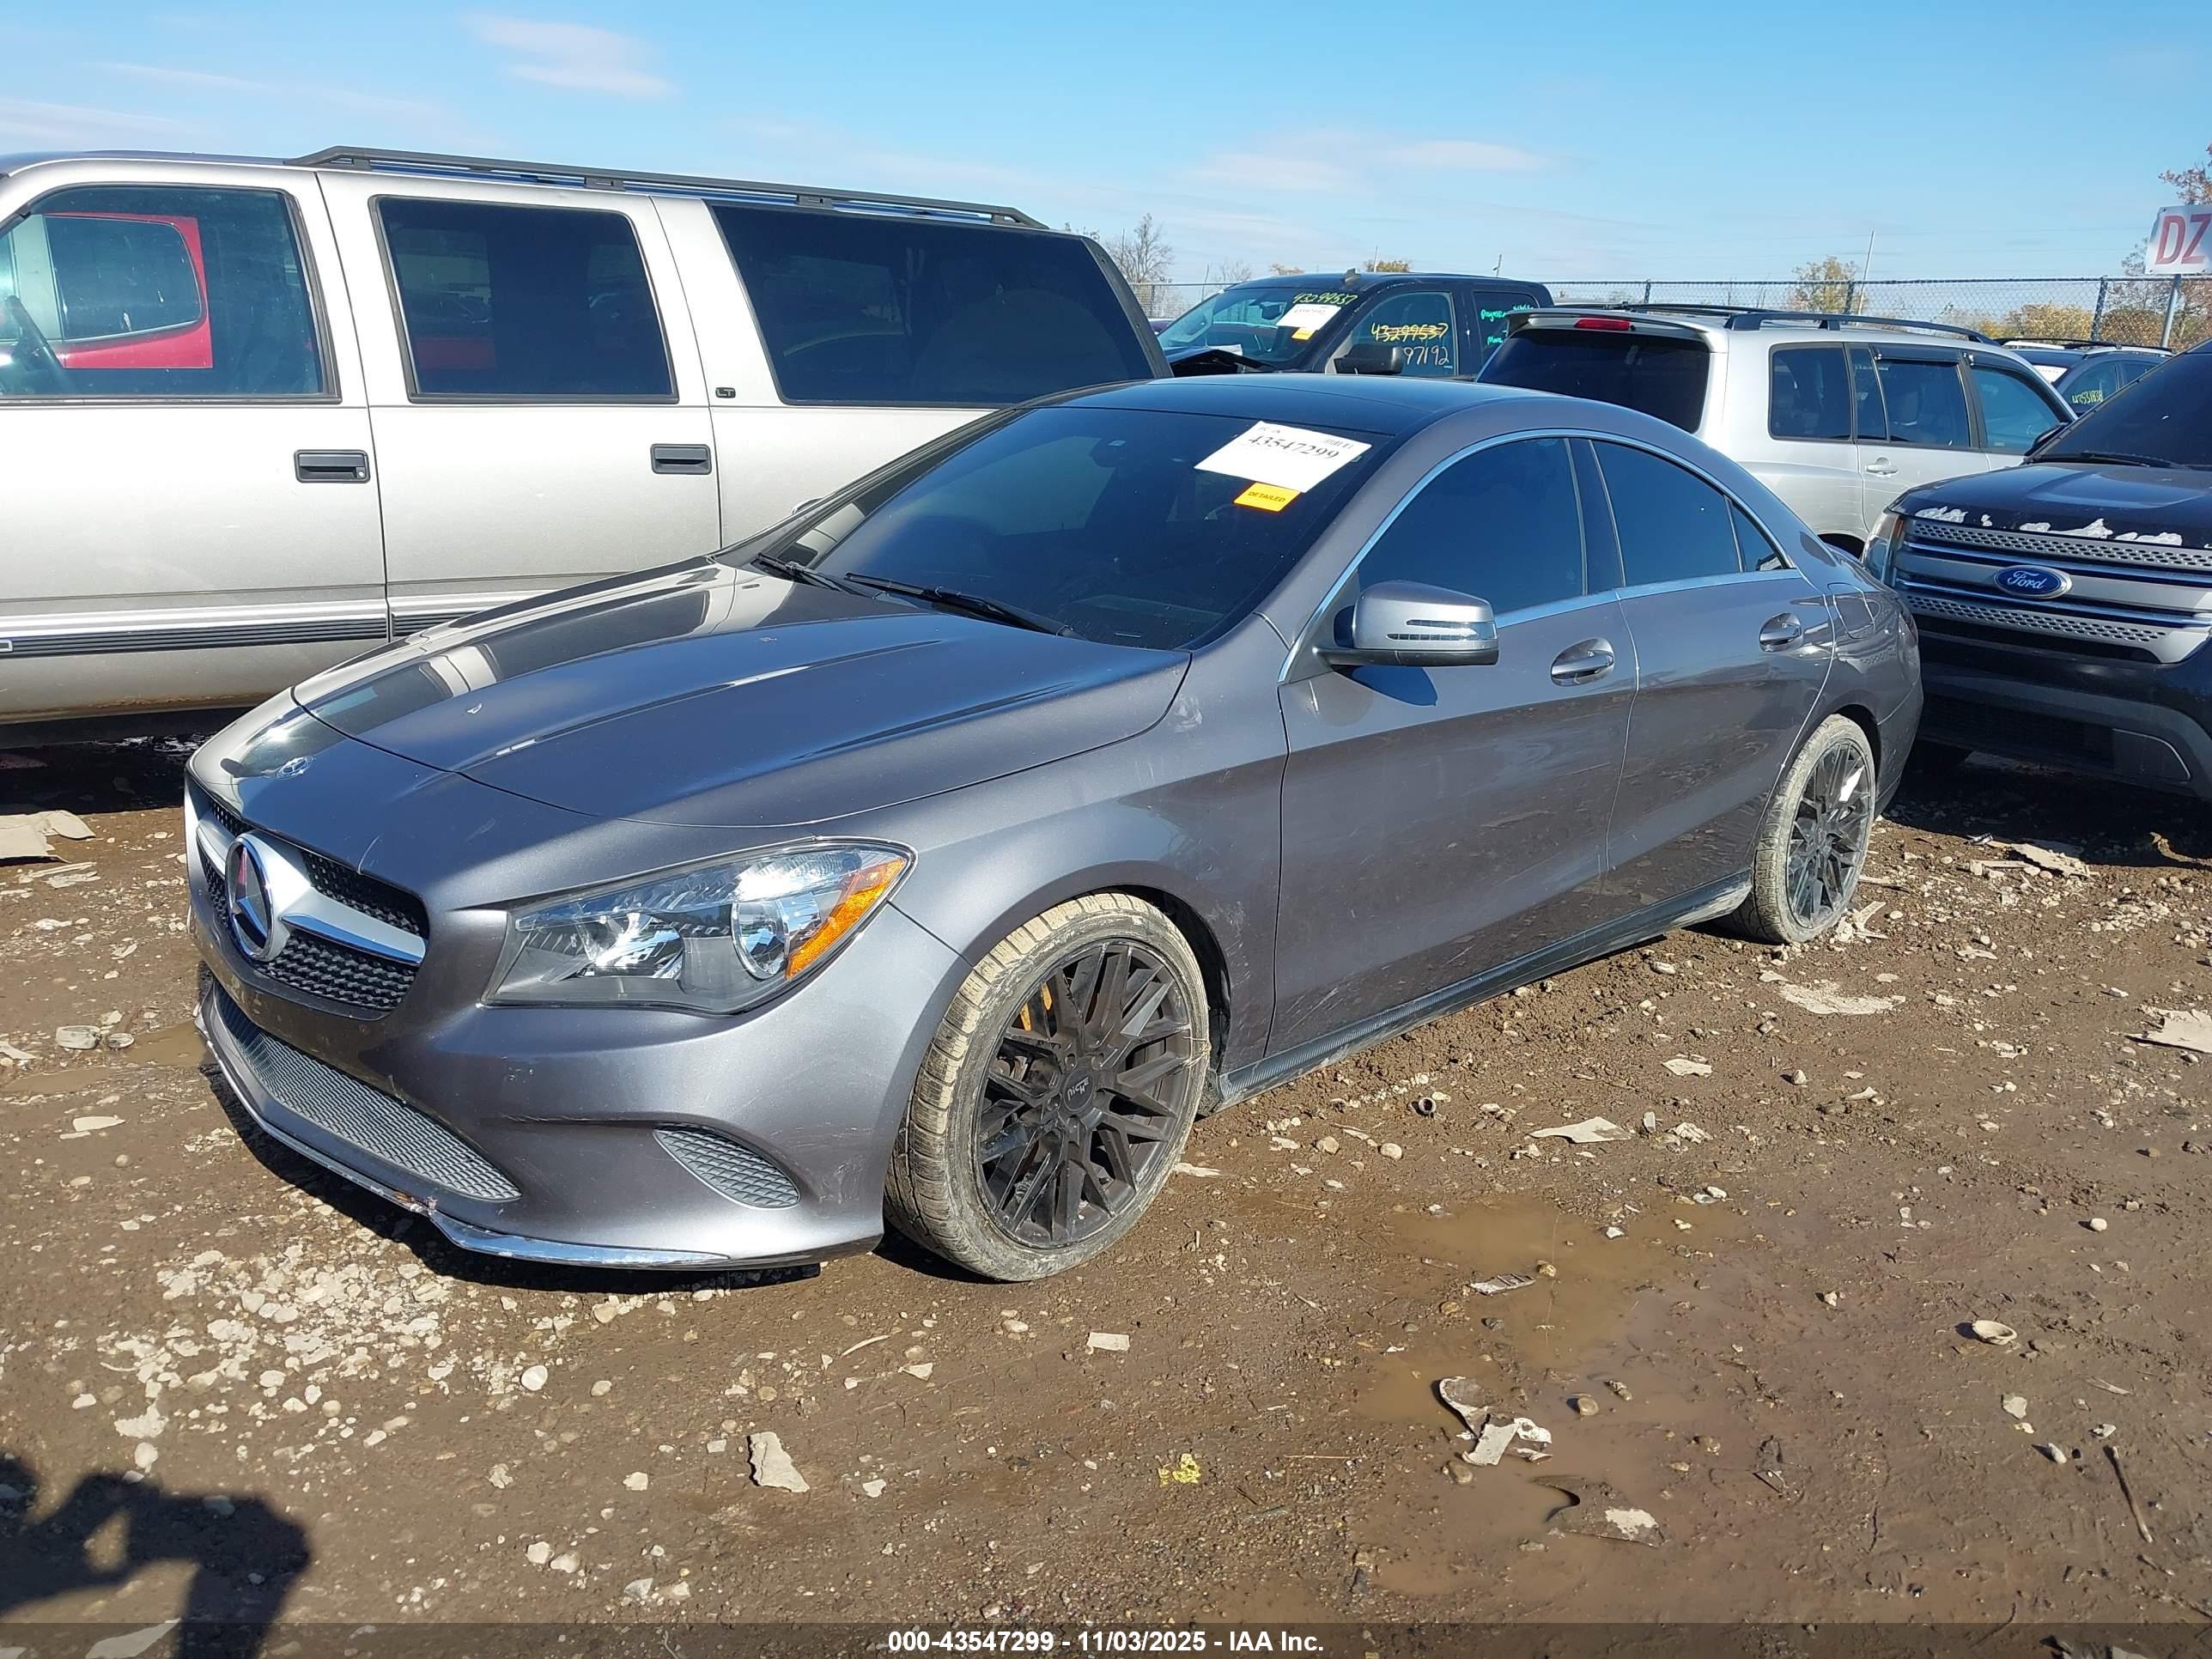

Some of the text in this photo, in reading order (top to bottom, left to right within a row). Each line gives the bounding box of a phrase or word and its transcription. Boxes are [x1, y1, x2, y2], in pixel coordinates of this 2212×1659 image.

[2154, 213, 2212, 265] DZ
[1370, 322, 1449, 343] 43299537
[716, 388, 735, 397] LT
[1248, 435, 1340, 459] 43547299
[1248, 490, 1286, 502] DETAILED
[2007, 570, 2048, 590] Ford
